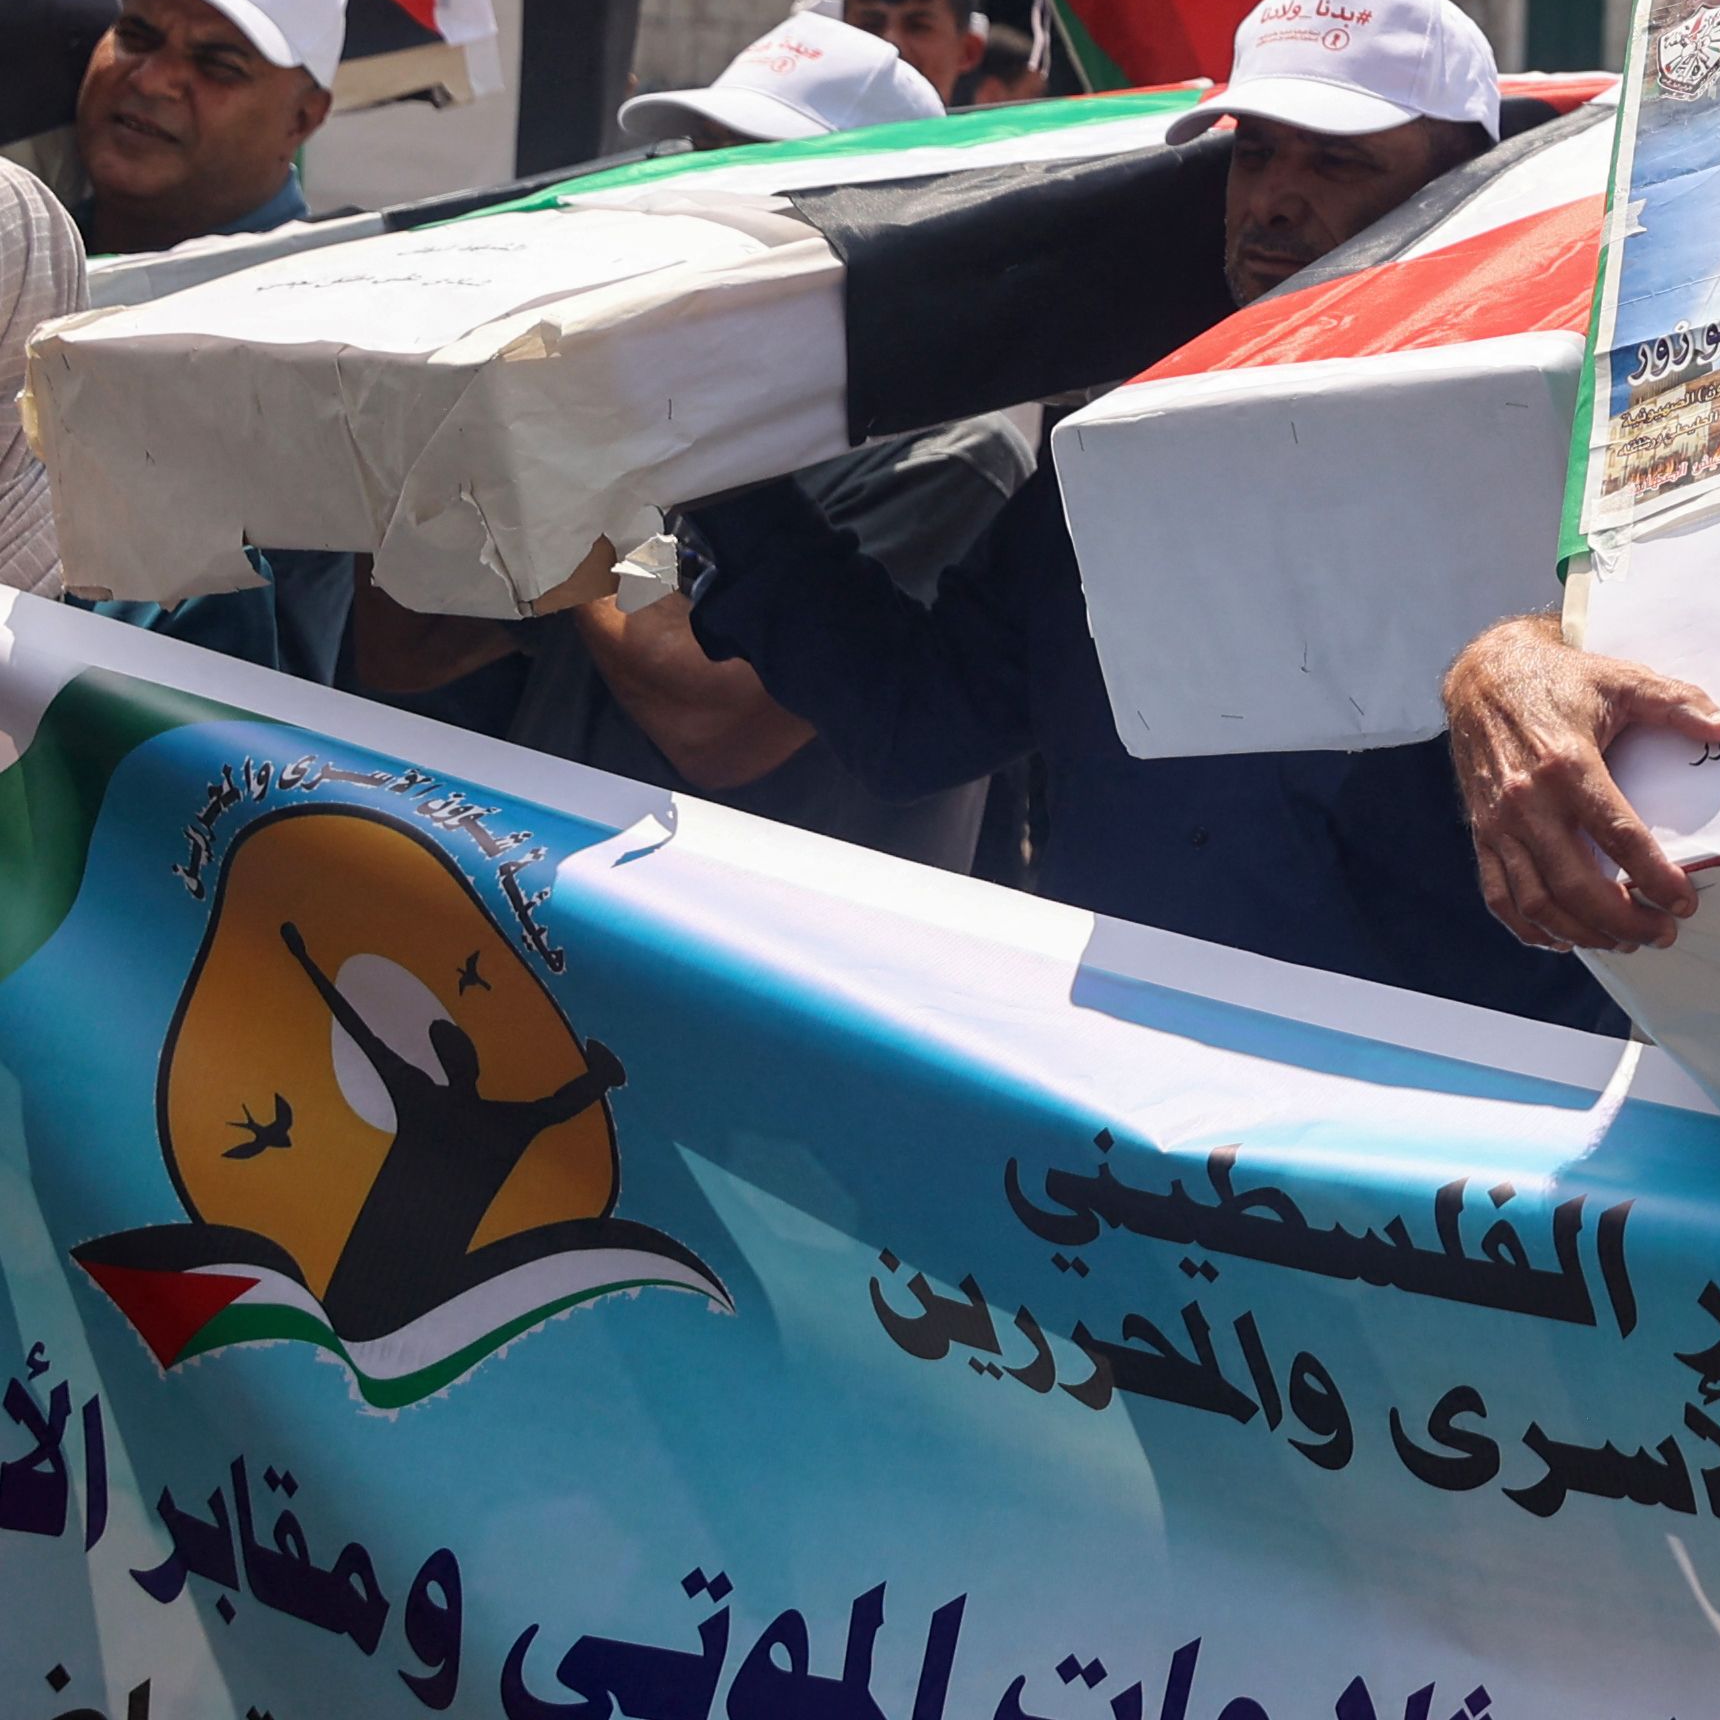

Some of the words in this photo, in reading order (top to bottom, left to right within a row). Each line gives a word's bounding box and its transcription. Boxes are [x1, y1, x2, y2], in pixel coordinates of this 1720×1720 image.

[1629, 323, 1692, 385] زور
[415, 792, 534, 859] شؤون
[1003, 1128, 1636, 1340] الفلسطيني
[868, 1247, 1354, 1470] والمحررين
[129, 1454, 464, 1710] ومقابر
